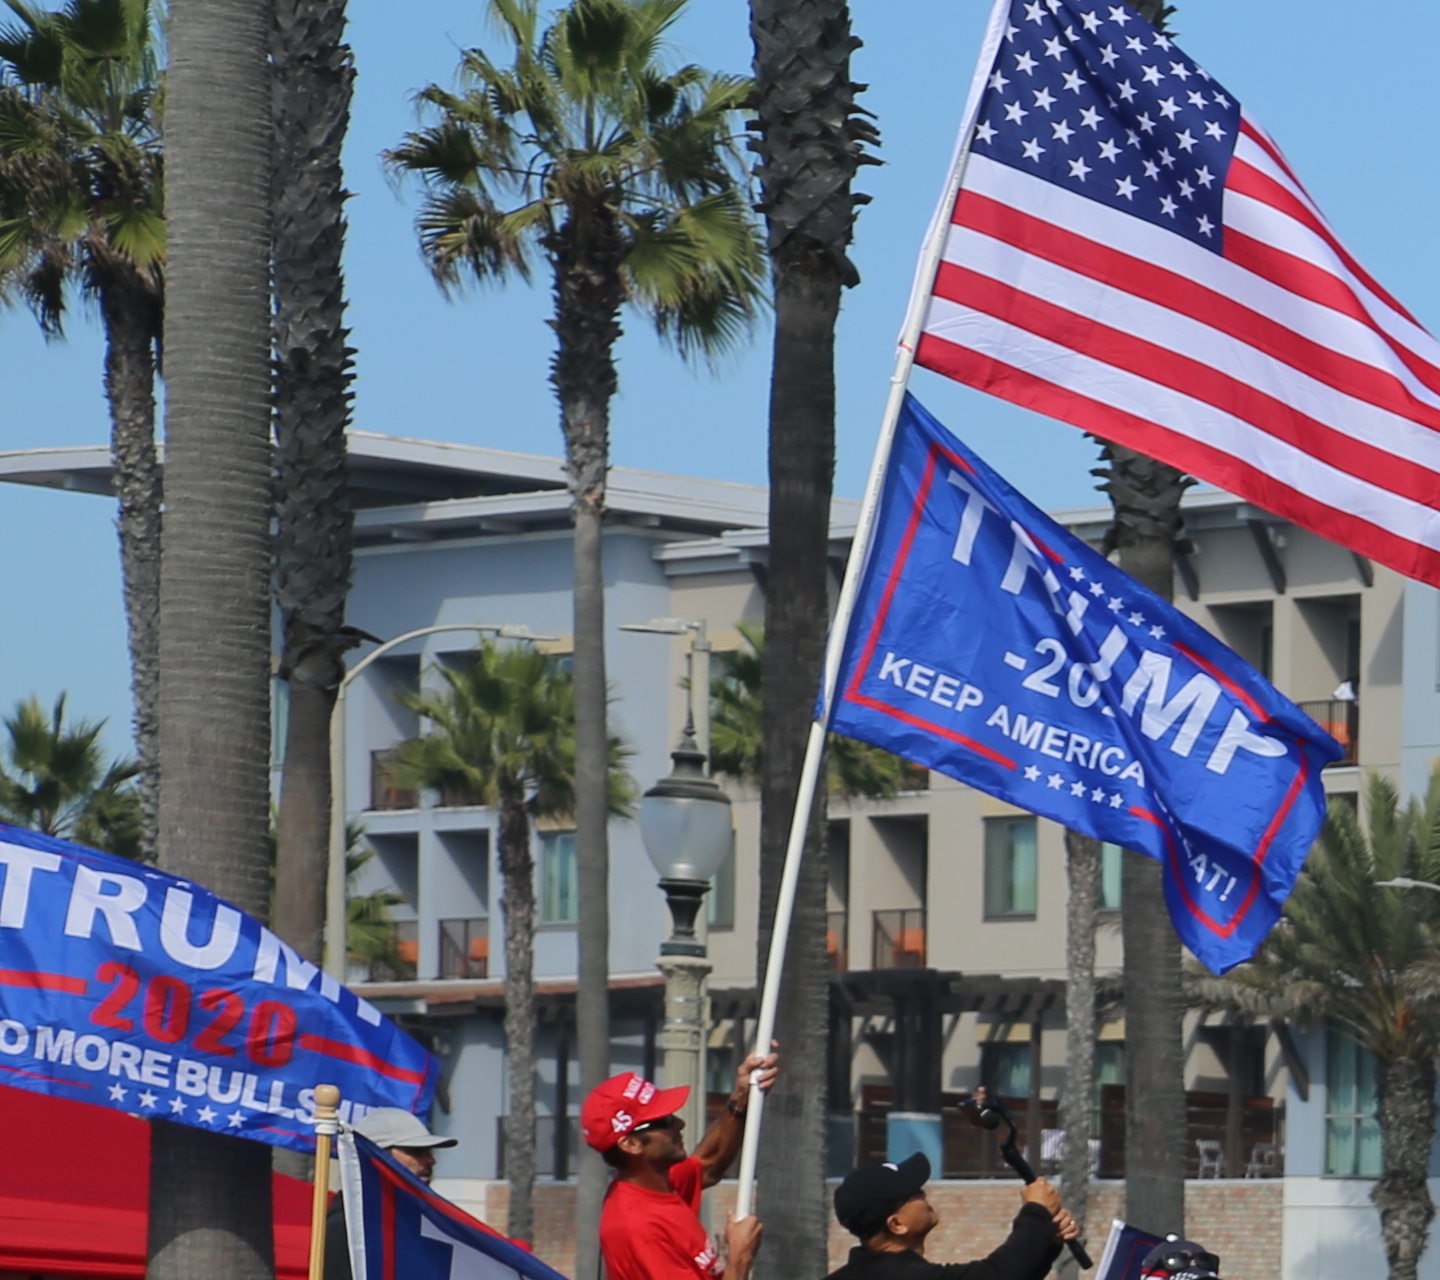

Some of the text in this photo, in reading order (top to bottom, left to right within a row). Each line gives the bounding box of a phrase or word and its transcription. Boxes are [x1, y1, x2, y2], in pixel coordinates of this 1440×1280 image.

[877, 652, 1146, 789] KEEP AMERICA
[33, 1024, 173, 1088] MORE
[89, 960, 298, 1069] 2020
[611, 1109, 634, 1133] 45
